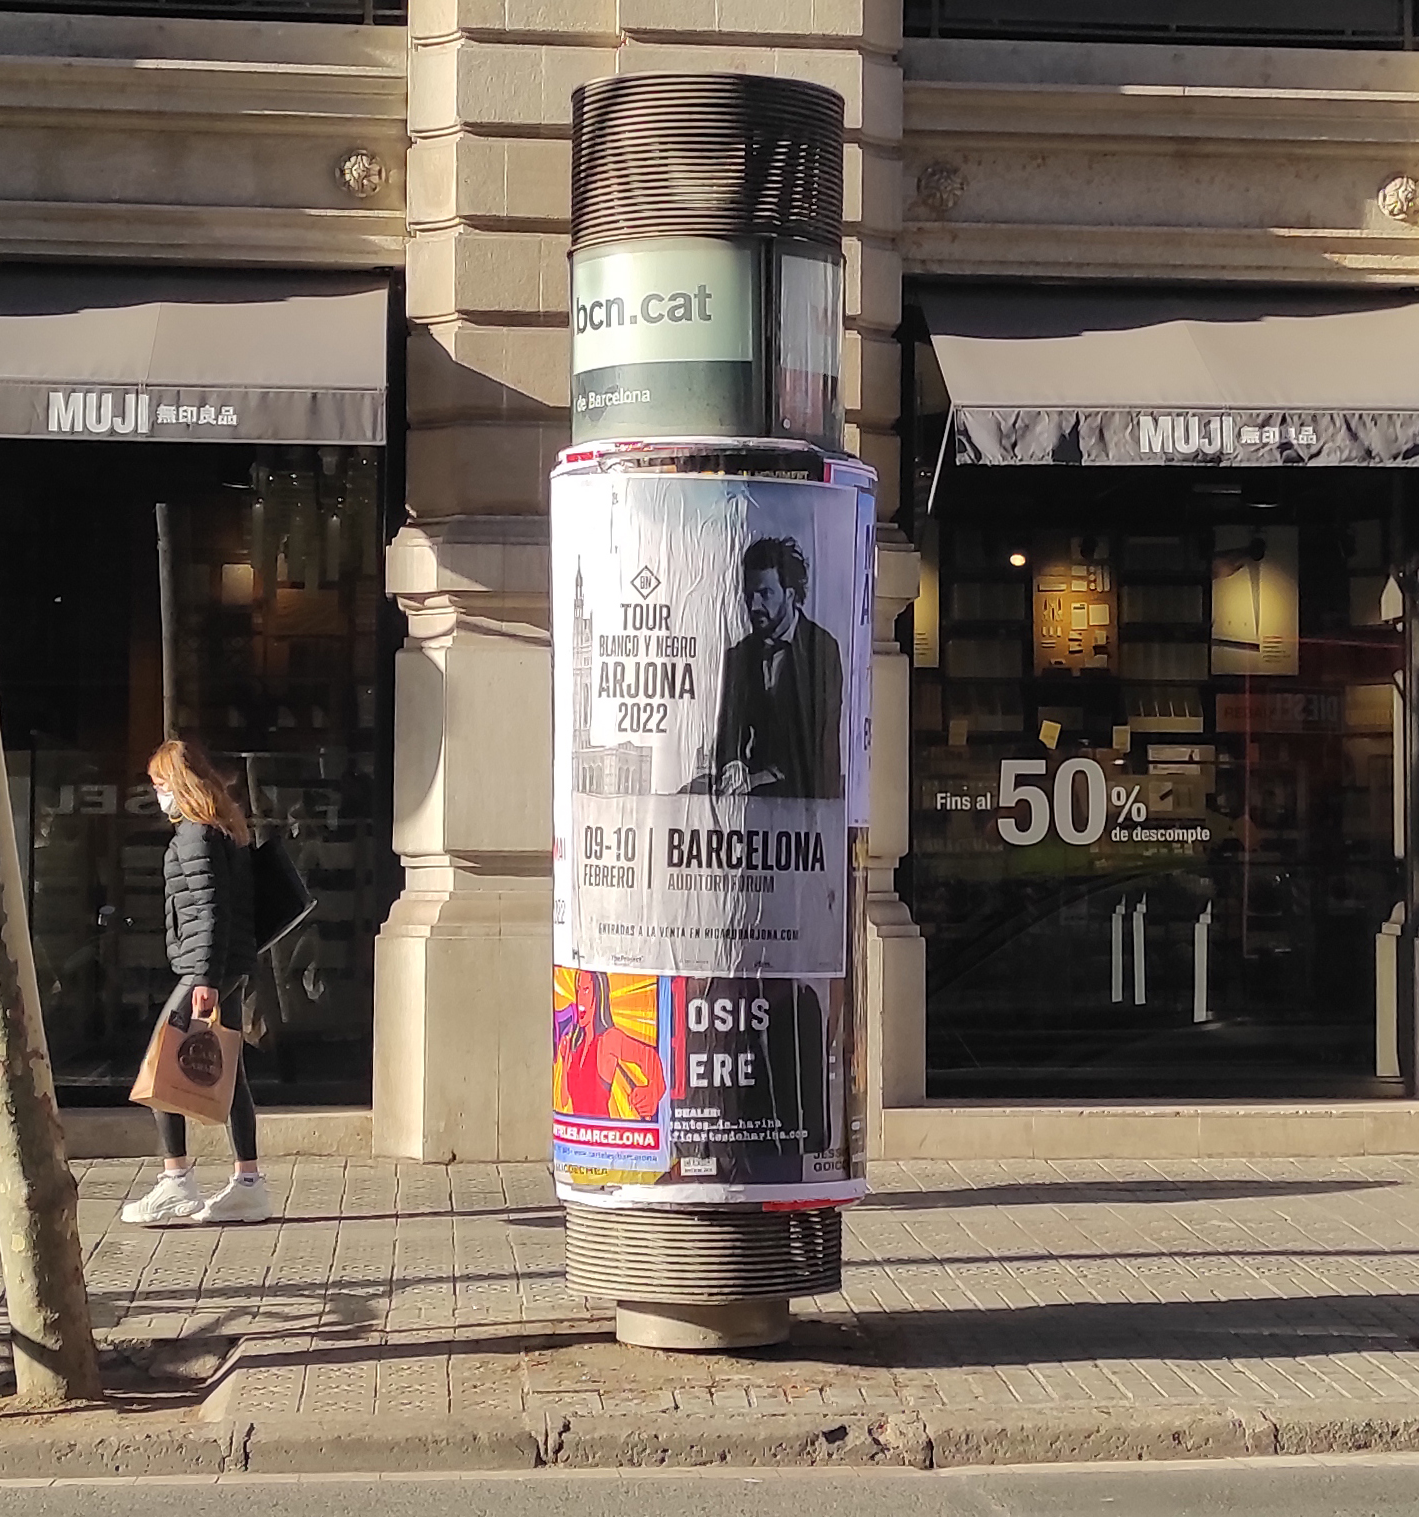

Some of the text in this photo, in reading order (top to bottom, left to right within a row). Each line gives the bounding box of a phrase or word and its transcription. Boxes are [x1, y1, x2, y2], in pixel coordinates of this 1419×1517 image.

[576, 284, 712, 335] bcn.cat
[48, 392, 238, 434] MUJI 無印良品
[577, 388, 651, 412] de Barcelona
[1139, 415, 1234, 454] MUJI
[620, 603, 671, 631] TOUR
[599, 635, 697, 658] BLANCO Y NEGRO
[598, 661, 696, 700] ARJONA
[617, 702, 668, 733] 2022
[936, 757, 1147, 846] Fins al 50%
[584, 825, 637, 862] 09-10
[666, 828, 826, 873] BARCELONA
[1111, 826, 1211, 845] de descompte
[583, 864, 635, 889] FEBRERO
[598, 922, 635, 936] ENTRADAS
[638, 925, 643, 936] A
[646, 926, 656, 937] LA
[659, 926, 686, 938] VENTA
[690, 928, 700, 939] EN
[688, 998, 770, 1032] OSIS
[689, 1053, 756, 1088] ERE
